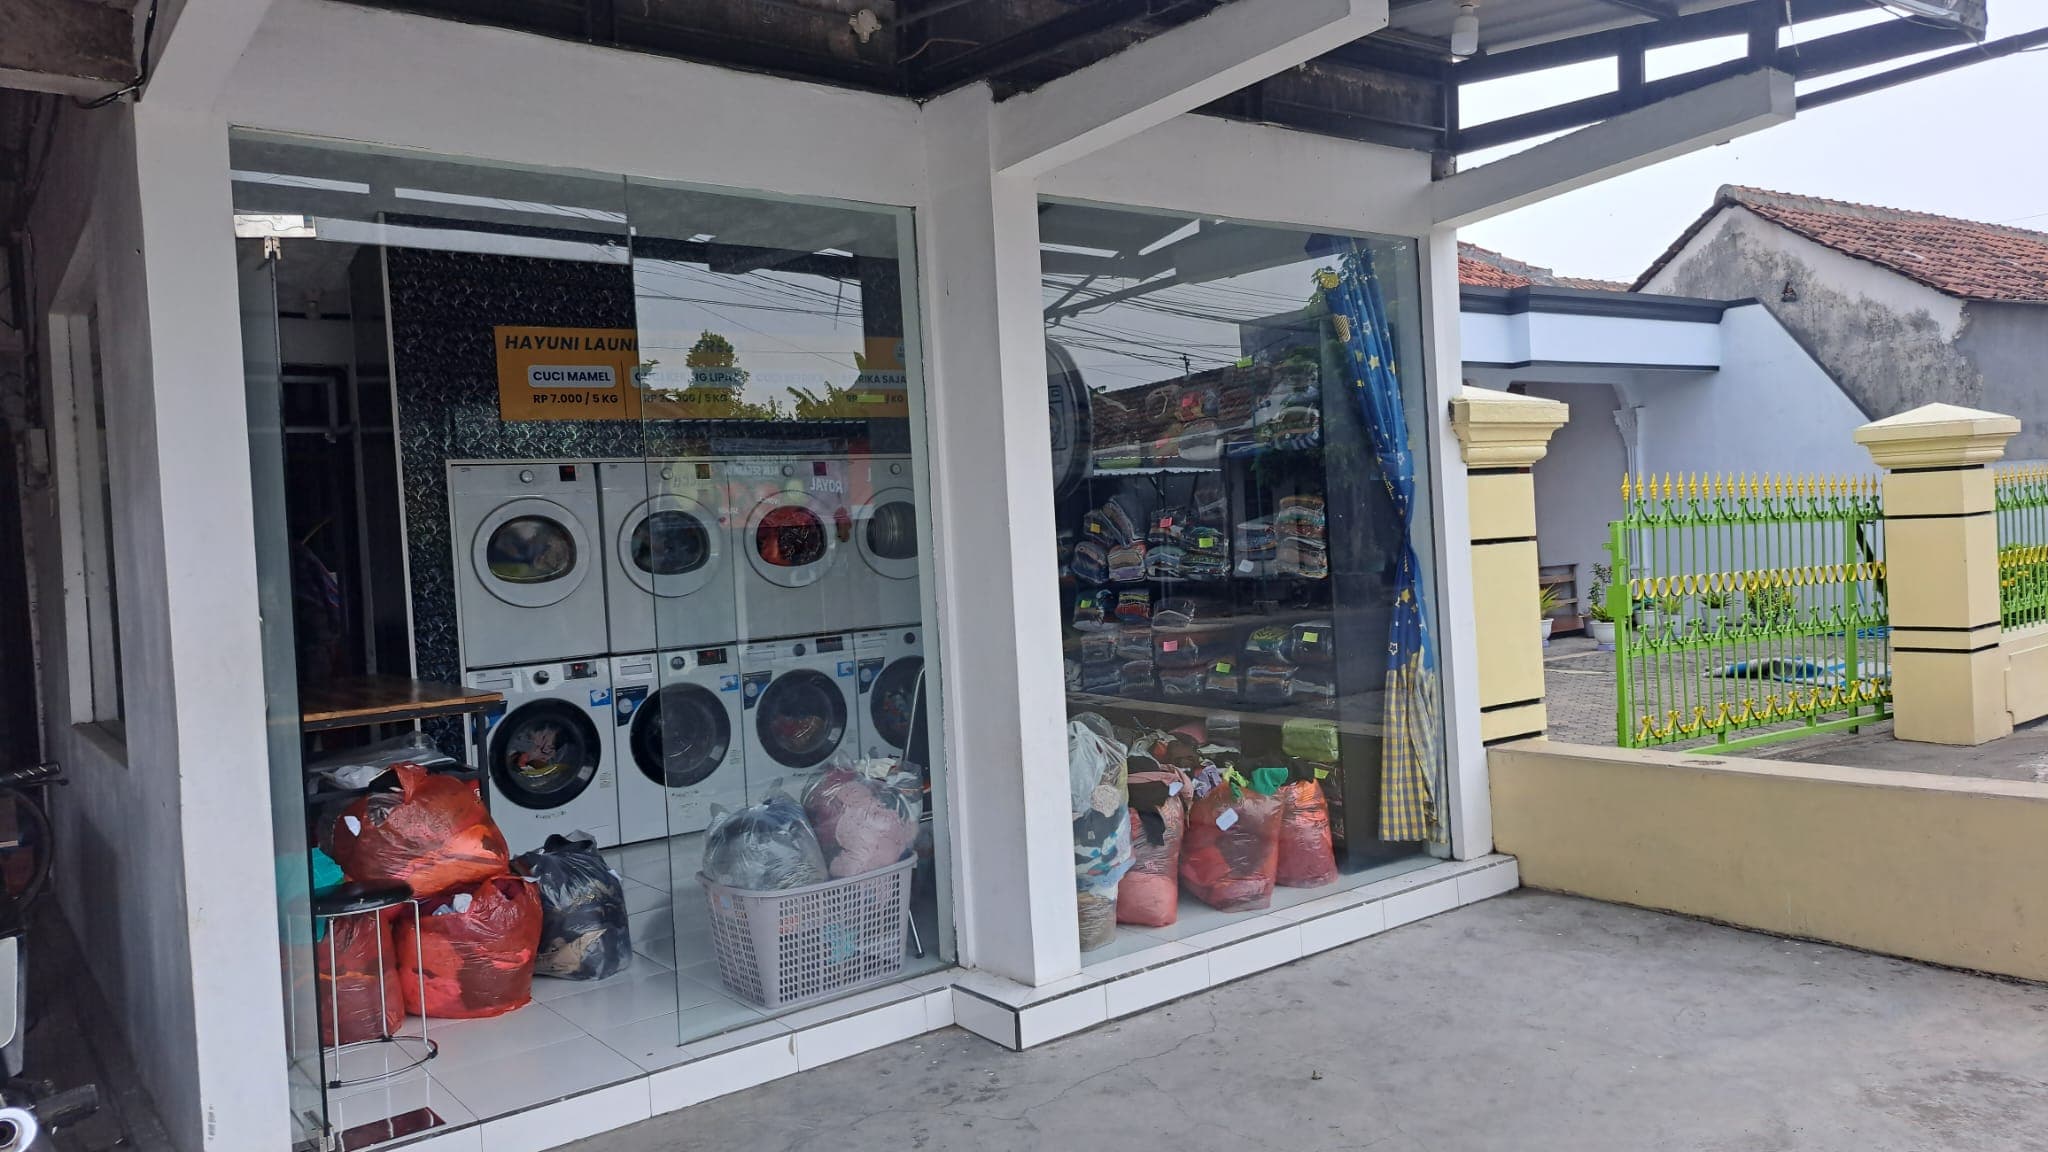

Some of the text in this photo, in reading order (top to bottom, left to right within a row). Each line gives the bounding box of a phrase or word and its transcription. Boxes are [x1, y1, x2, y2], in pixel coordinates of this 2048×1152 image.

[505, 336, 580, 351] HAYUNI
[533, 371, 611, 383] CUCI MAMEL
[533, 394, 548, 404] RP
[551, 394, 583, 404] 7.000
[592, 394, 600, 403] 5
[602, 394, 619, 404] KG
